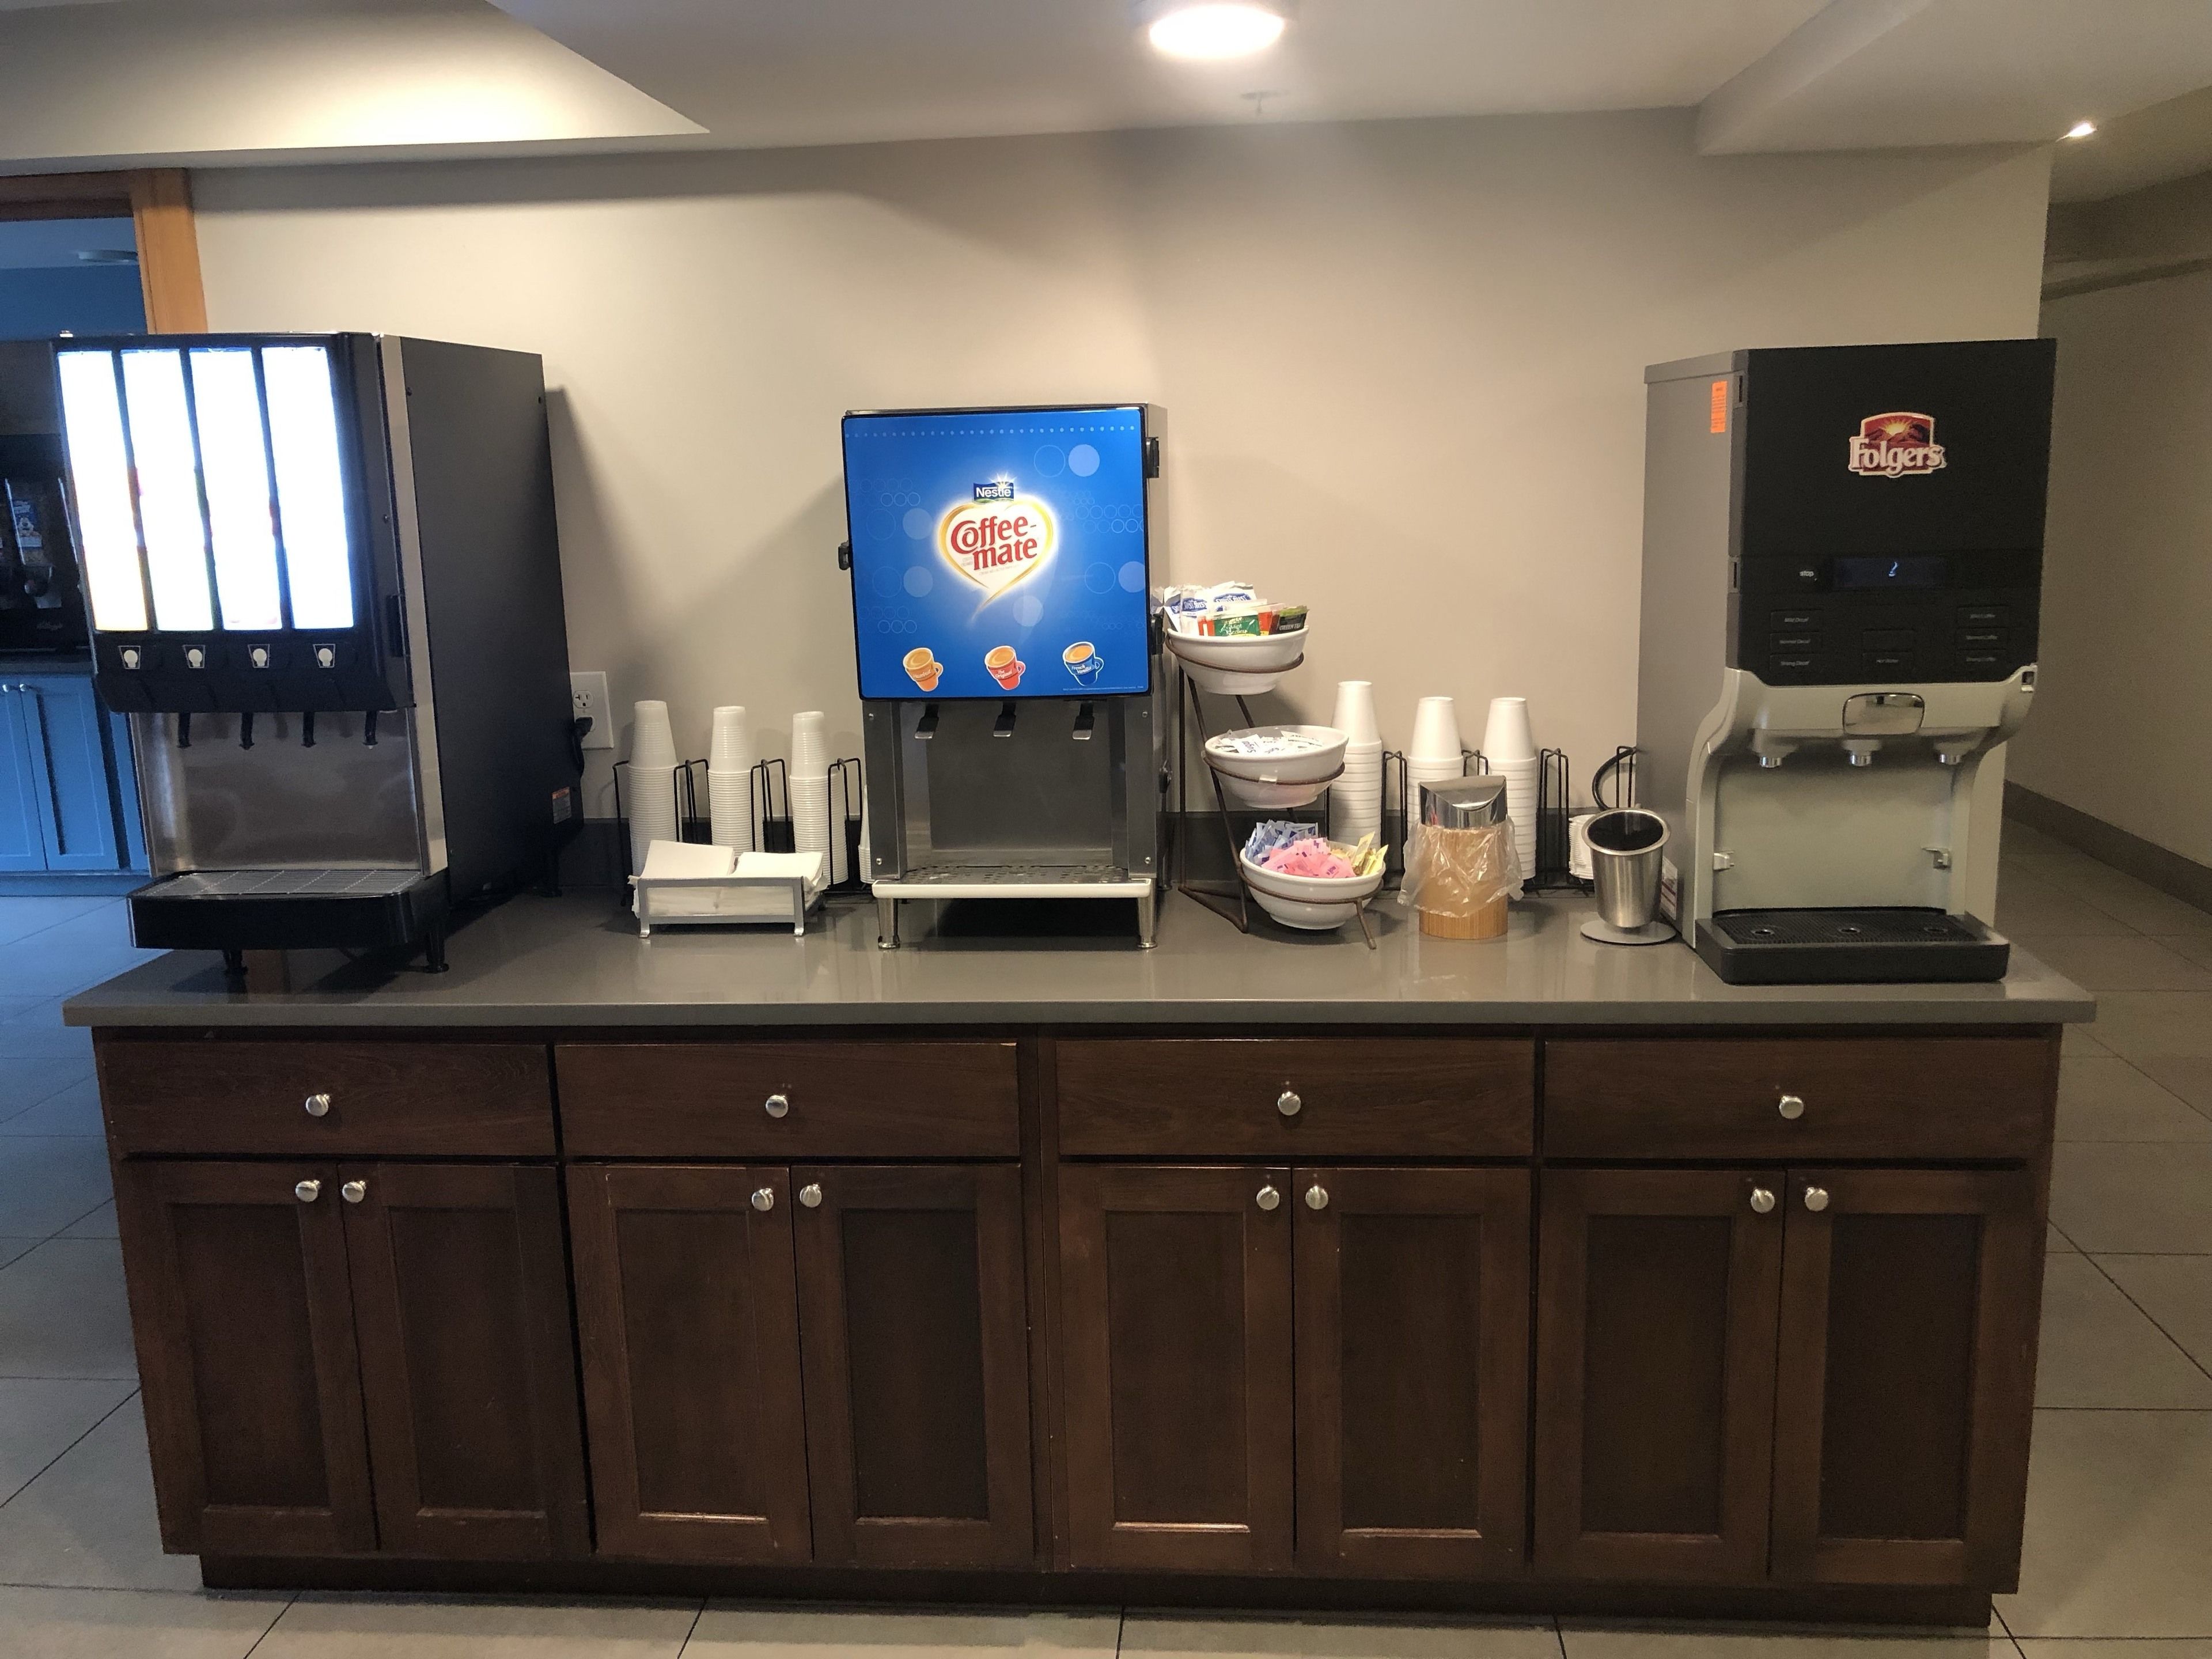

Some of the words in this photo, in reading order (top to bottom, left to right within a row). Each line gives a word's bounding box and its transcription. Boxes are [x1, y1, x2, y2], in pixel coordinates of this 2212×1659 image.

[1850, 438, 1942, 475] Folgers
[973, 538, 1037, 570] mate
[995, 670, 1013, 679] Original
